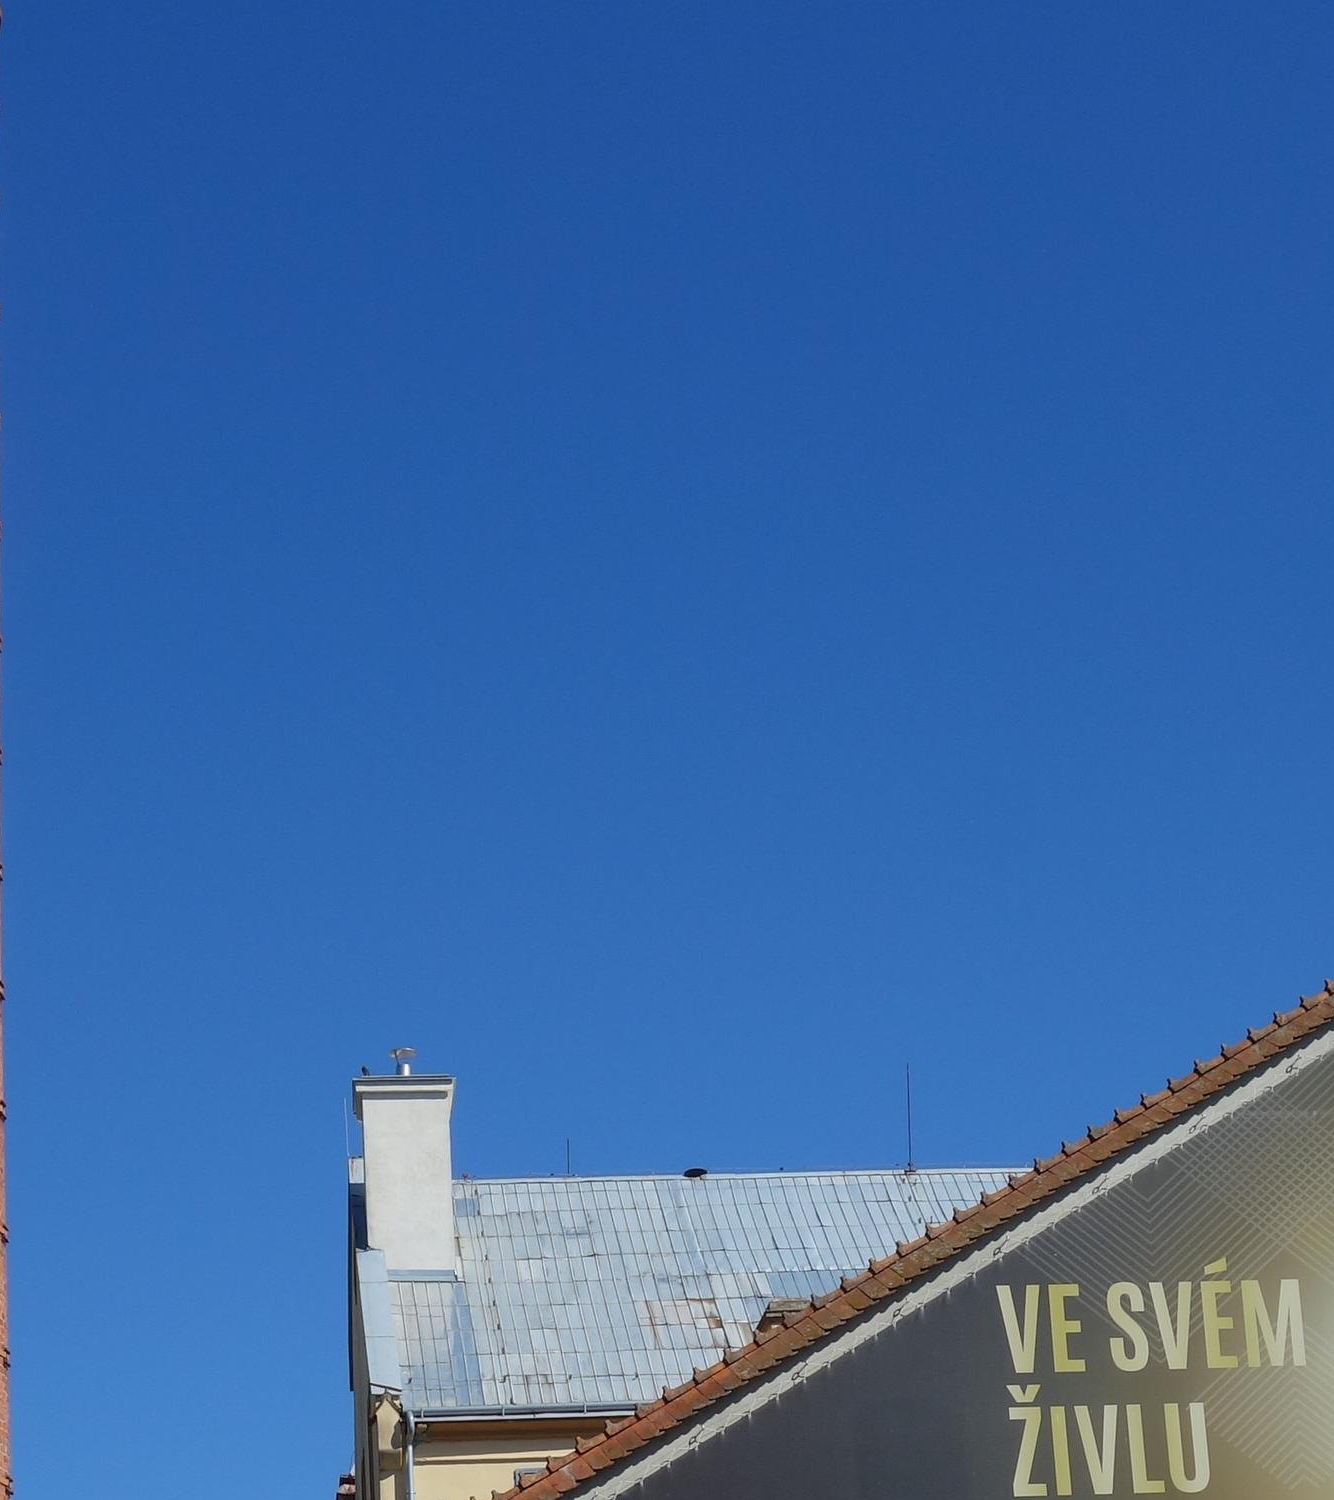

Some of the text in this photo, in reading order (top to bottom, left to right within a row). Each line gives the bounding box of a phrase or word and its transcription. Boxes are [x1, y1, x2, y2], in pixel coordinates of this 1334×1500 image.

[996, 1257, 1307, 1373] VE SVÉM
[1005, 1384, 1210, 1497] ŽIVLU
